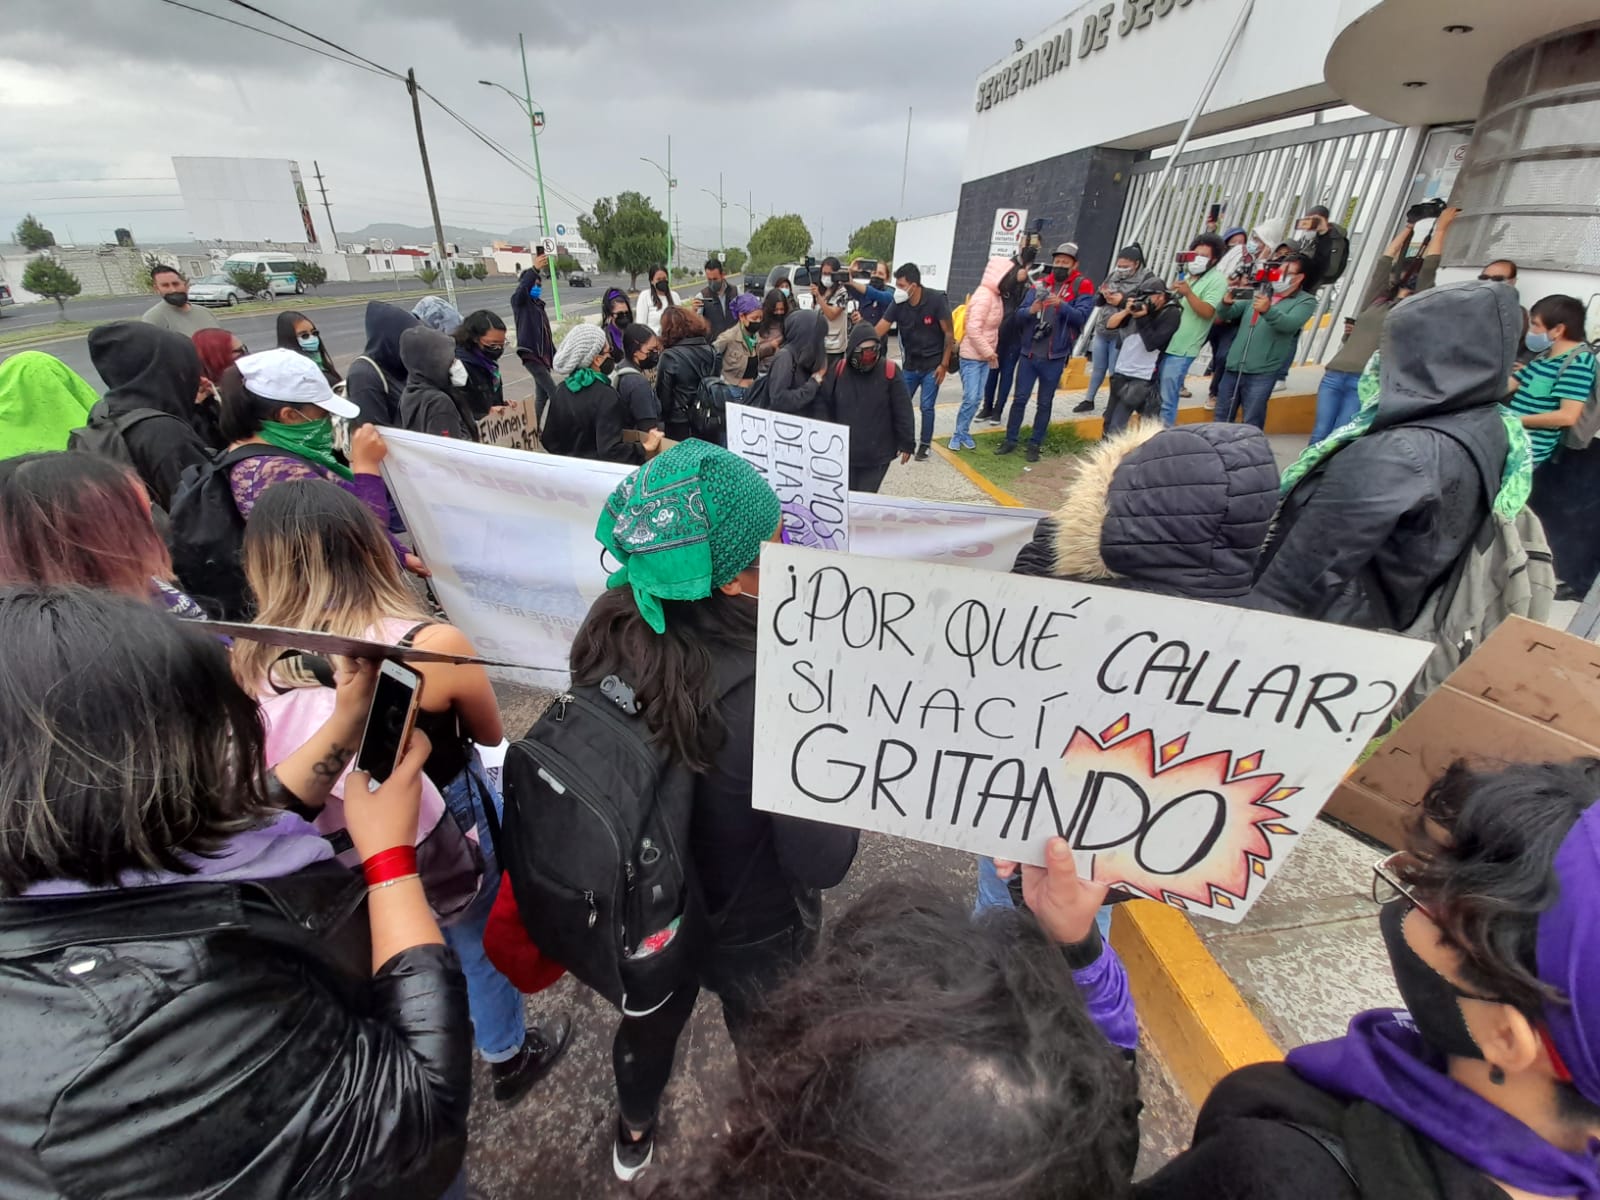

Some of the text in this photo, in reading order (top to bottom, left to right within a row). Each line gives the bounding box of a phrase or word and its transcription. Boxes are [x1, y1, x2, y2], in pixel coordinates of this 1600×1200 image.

[976, 0, 1193, 113] SECRETARIA DE SE
[1006, 215, 1015, 227] E
[774, 420, 804, 455] DE
[775, 460, 804, 504] LAS
[808, 430, 846, 540] SOMOS
[772, 563, 1398, 743] ¿POR QUÉ CALLAR?
[787, 660, 1069, 750] SI NACÍ
[790, 722, 1227, 876] GRITANDO
